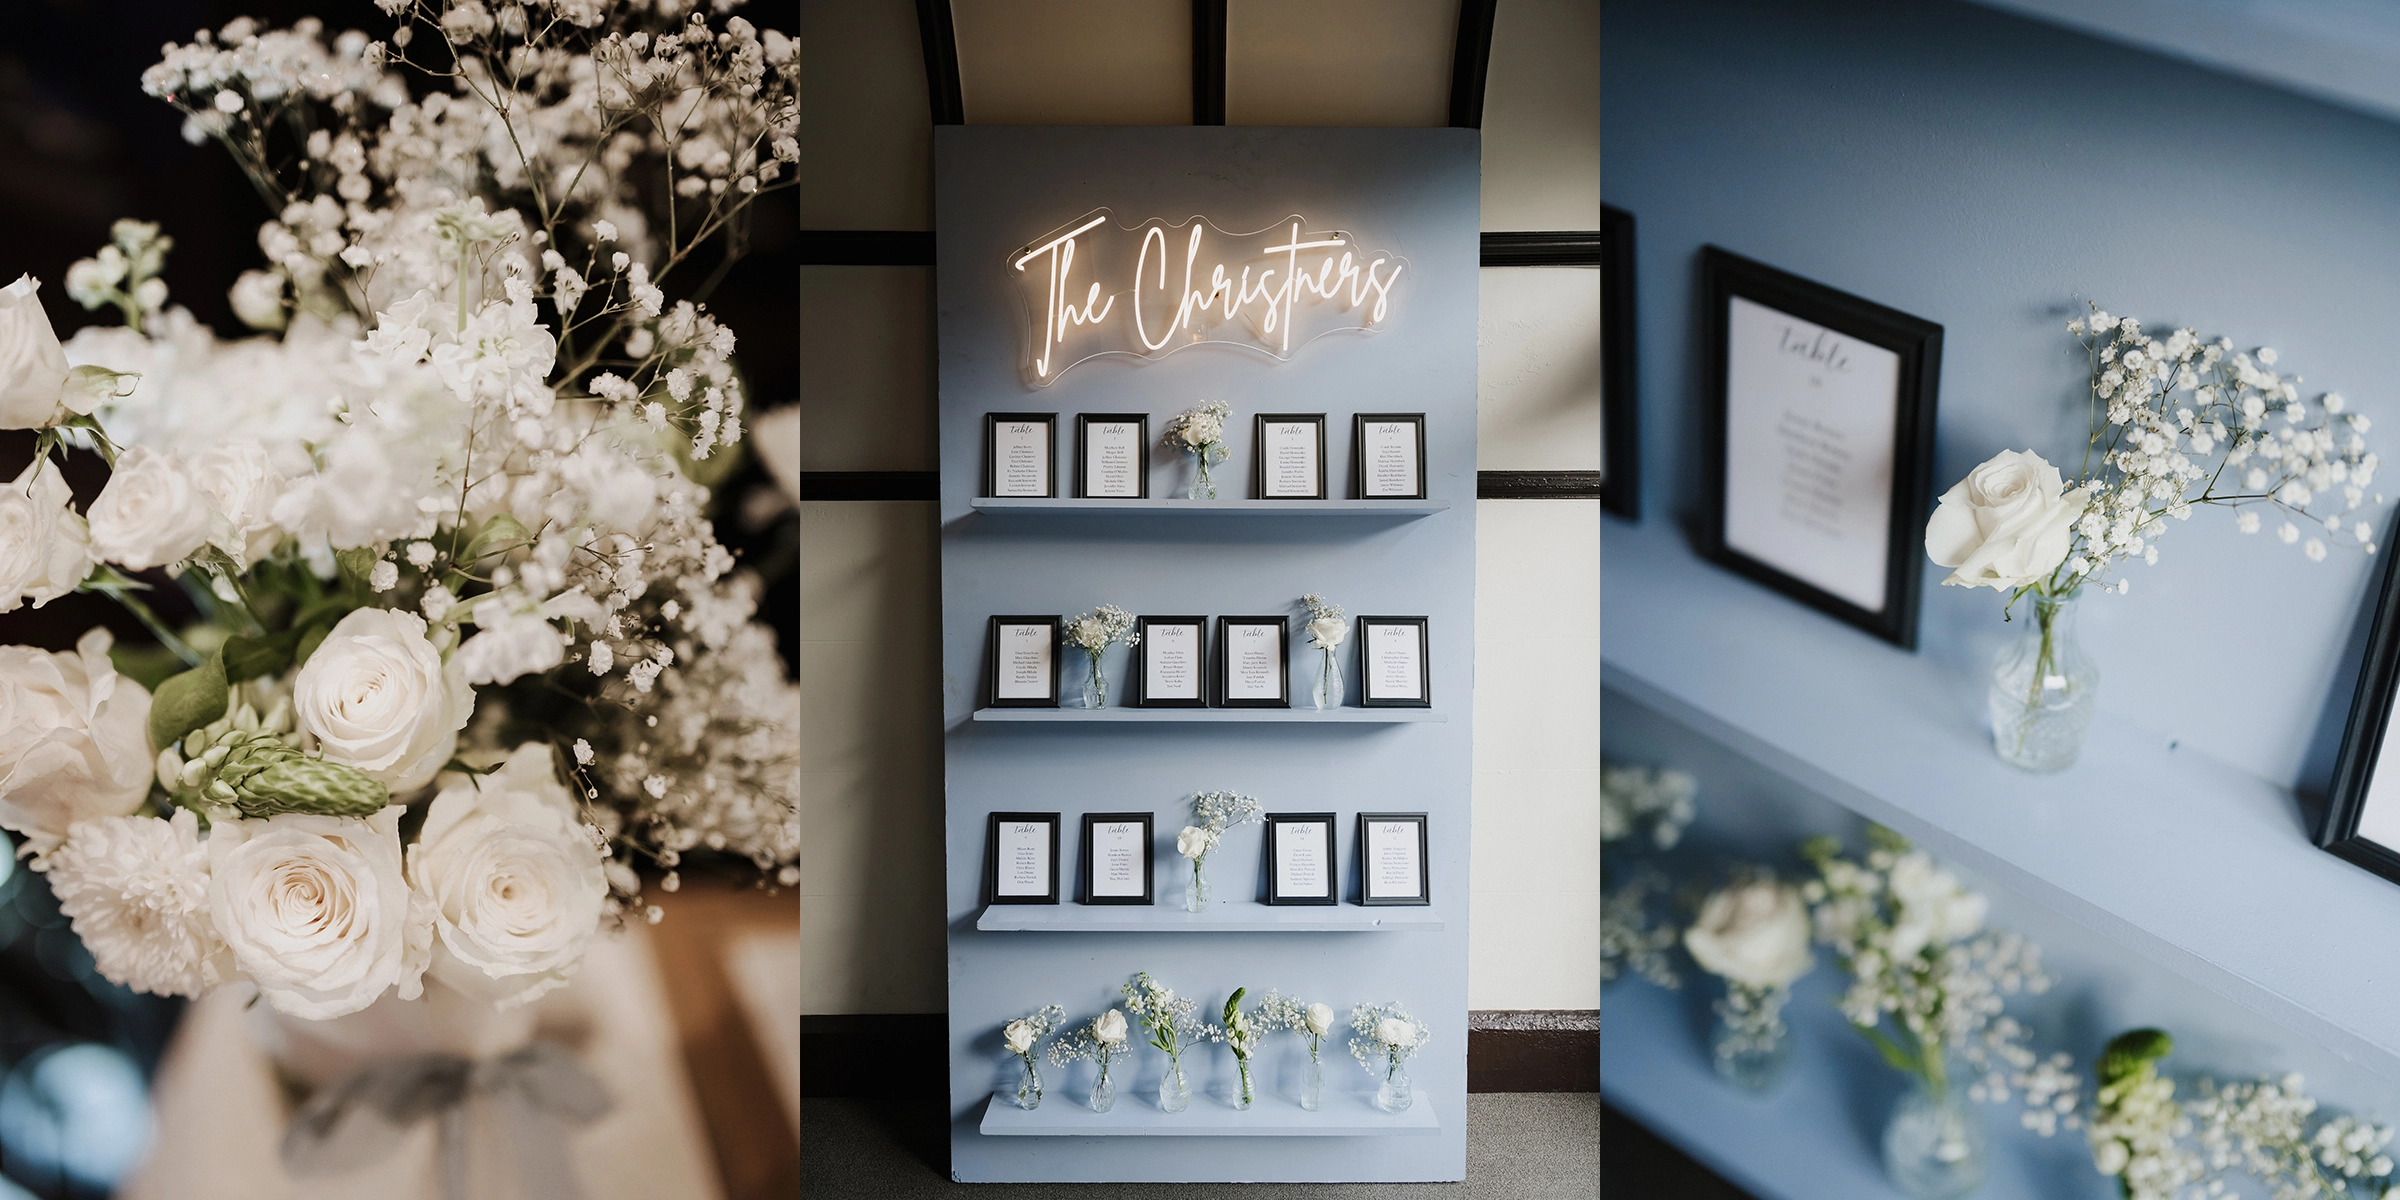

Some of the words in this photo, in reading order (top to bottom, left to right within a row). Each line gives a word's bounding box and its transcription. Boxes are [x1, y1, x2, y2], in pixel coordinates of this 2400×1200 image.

[1015, 215, 1115, 377] The
[1134, 222, 1402, 351] Christners
[1773, 323, 1853, 374] table
[1009, 423, 1033, 434] table
[1102, 424, 1126, 435] table
[1279, 425, 1303, 435] table
[1378, 424, 1401, 434] table
[1014, 627, 1038, 637] table
[1160, 626, 1184, 637] table
[1241, 627, 1266, 637] table
[1383, 626, 1406, 637] table
[1013, 824, 1037, 834] table
[1107, 824, 1130, 834] table
[1290, 824, 1313, 835] table
[1383, 824, 1405, 834] table
